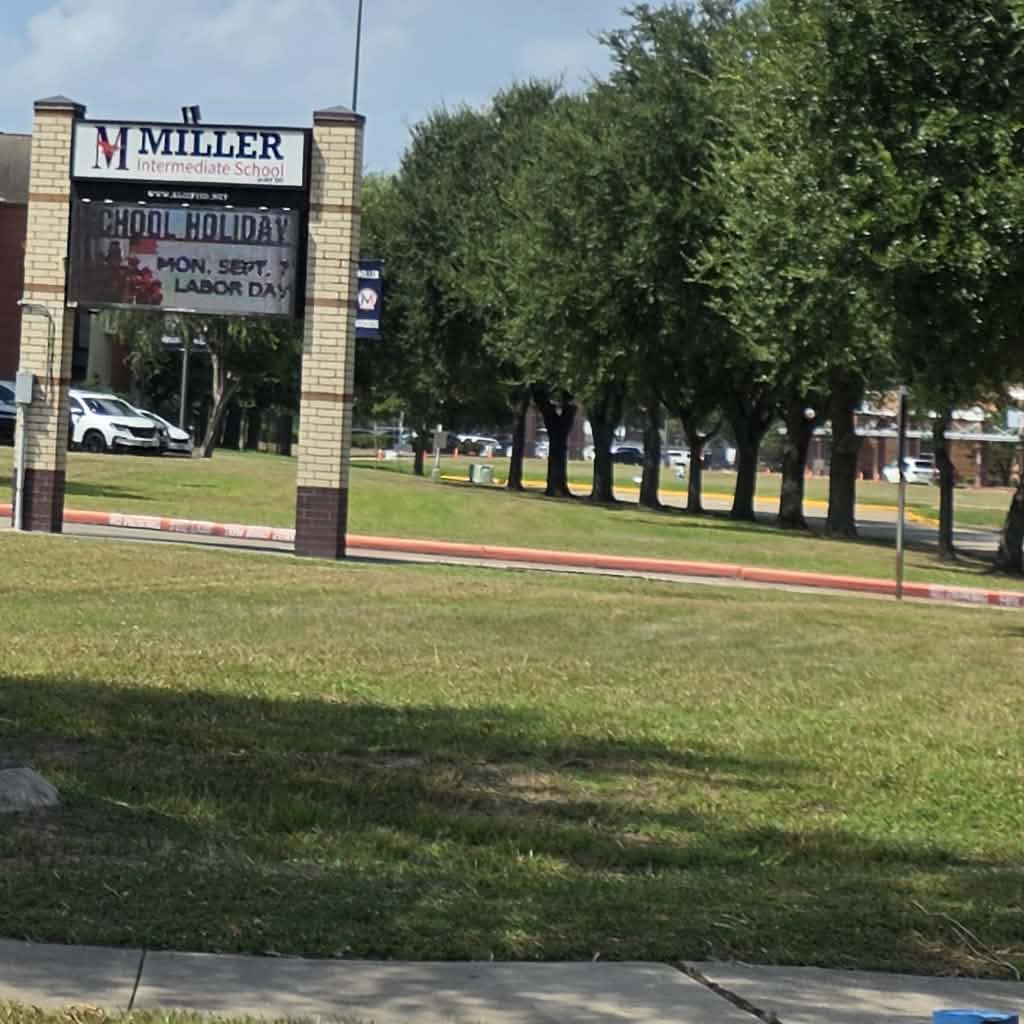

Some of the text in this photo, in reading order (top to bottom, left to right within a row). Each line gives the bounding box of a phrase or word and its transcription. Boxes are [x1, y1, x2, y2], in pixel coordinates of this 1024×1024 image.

[137, 127, 284, 160] MILLER
[136, 159, 284, 179] Intermediate School
[95, 208, 289, 243] CHOOL HOLIDAY
[175, 278, 243, 296] LABOR
